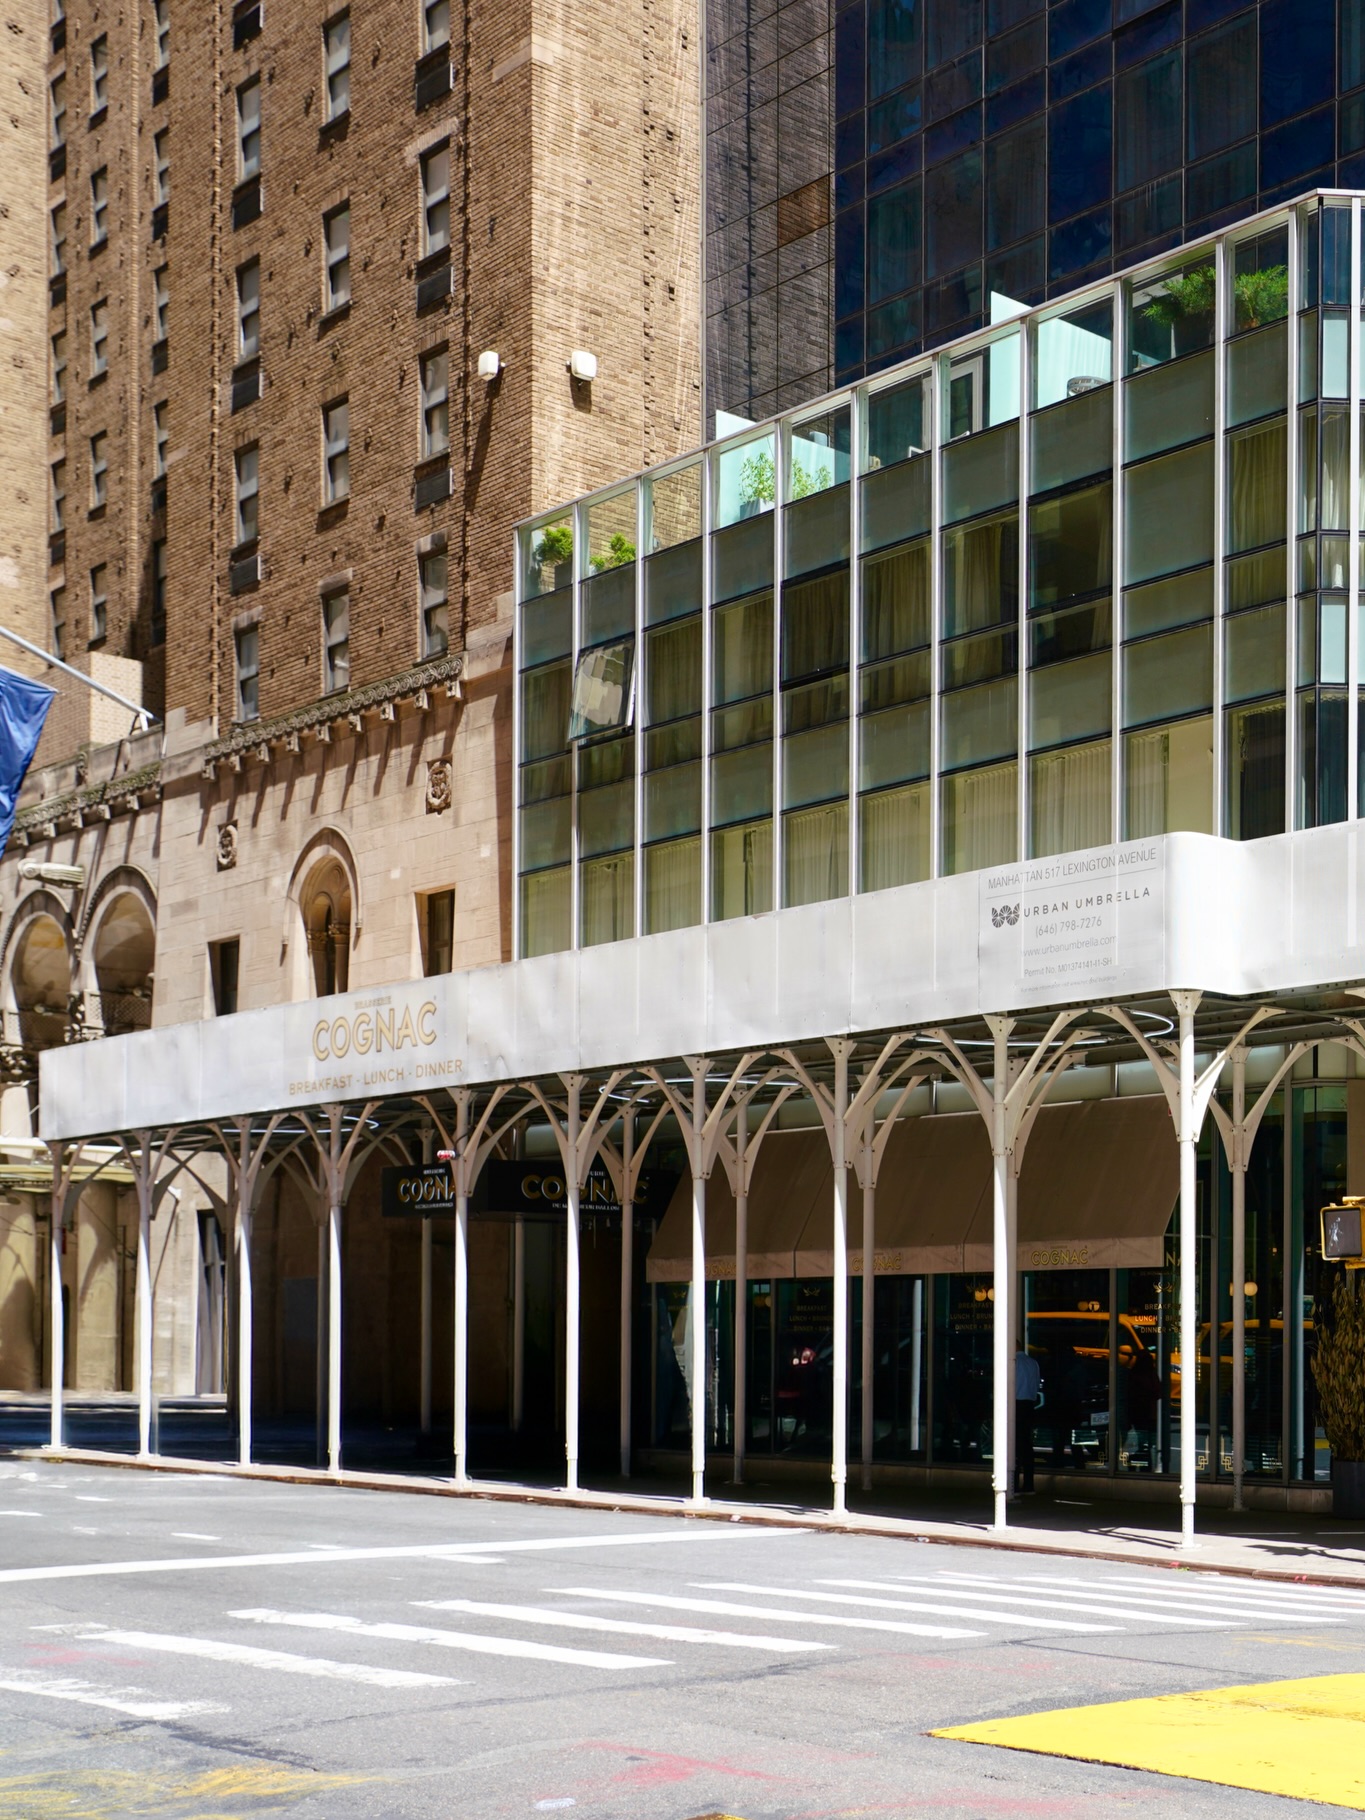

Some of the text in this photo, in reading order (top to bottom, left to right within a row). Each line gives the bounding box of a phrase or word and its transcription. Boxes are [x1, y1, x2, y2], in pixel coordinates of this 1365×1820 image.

[1045, 866, 1060, 879] 517
[1063, 856, 1116, 877] LEXINGTON
[1118, 847, 1157, 866] AVENUE
[1023, 887, 1150, 917] URBAN UMBRELLA
[1035, 915, 1102, 938] (646) 798-7276
[1024, 967, 1044, 978] Permit
[312, 1001, 437, 1062] COGNAC
[289, 1074, 352, 1096] BREAKFAST
[363, 1067, 404, 1086] LUNCH
[415, 1059, 463, 1079] DINNER
[1030, 1248, 1089, 1266] COGNAC
[1134, 1314, 1158, 1322] LUNCH
[1140, 1326, 1167, 1334] DINNER
